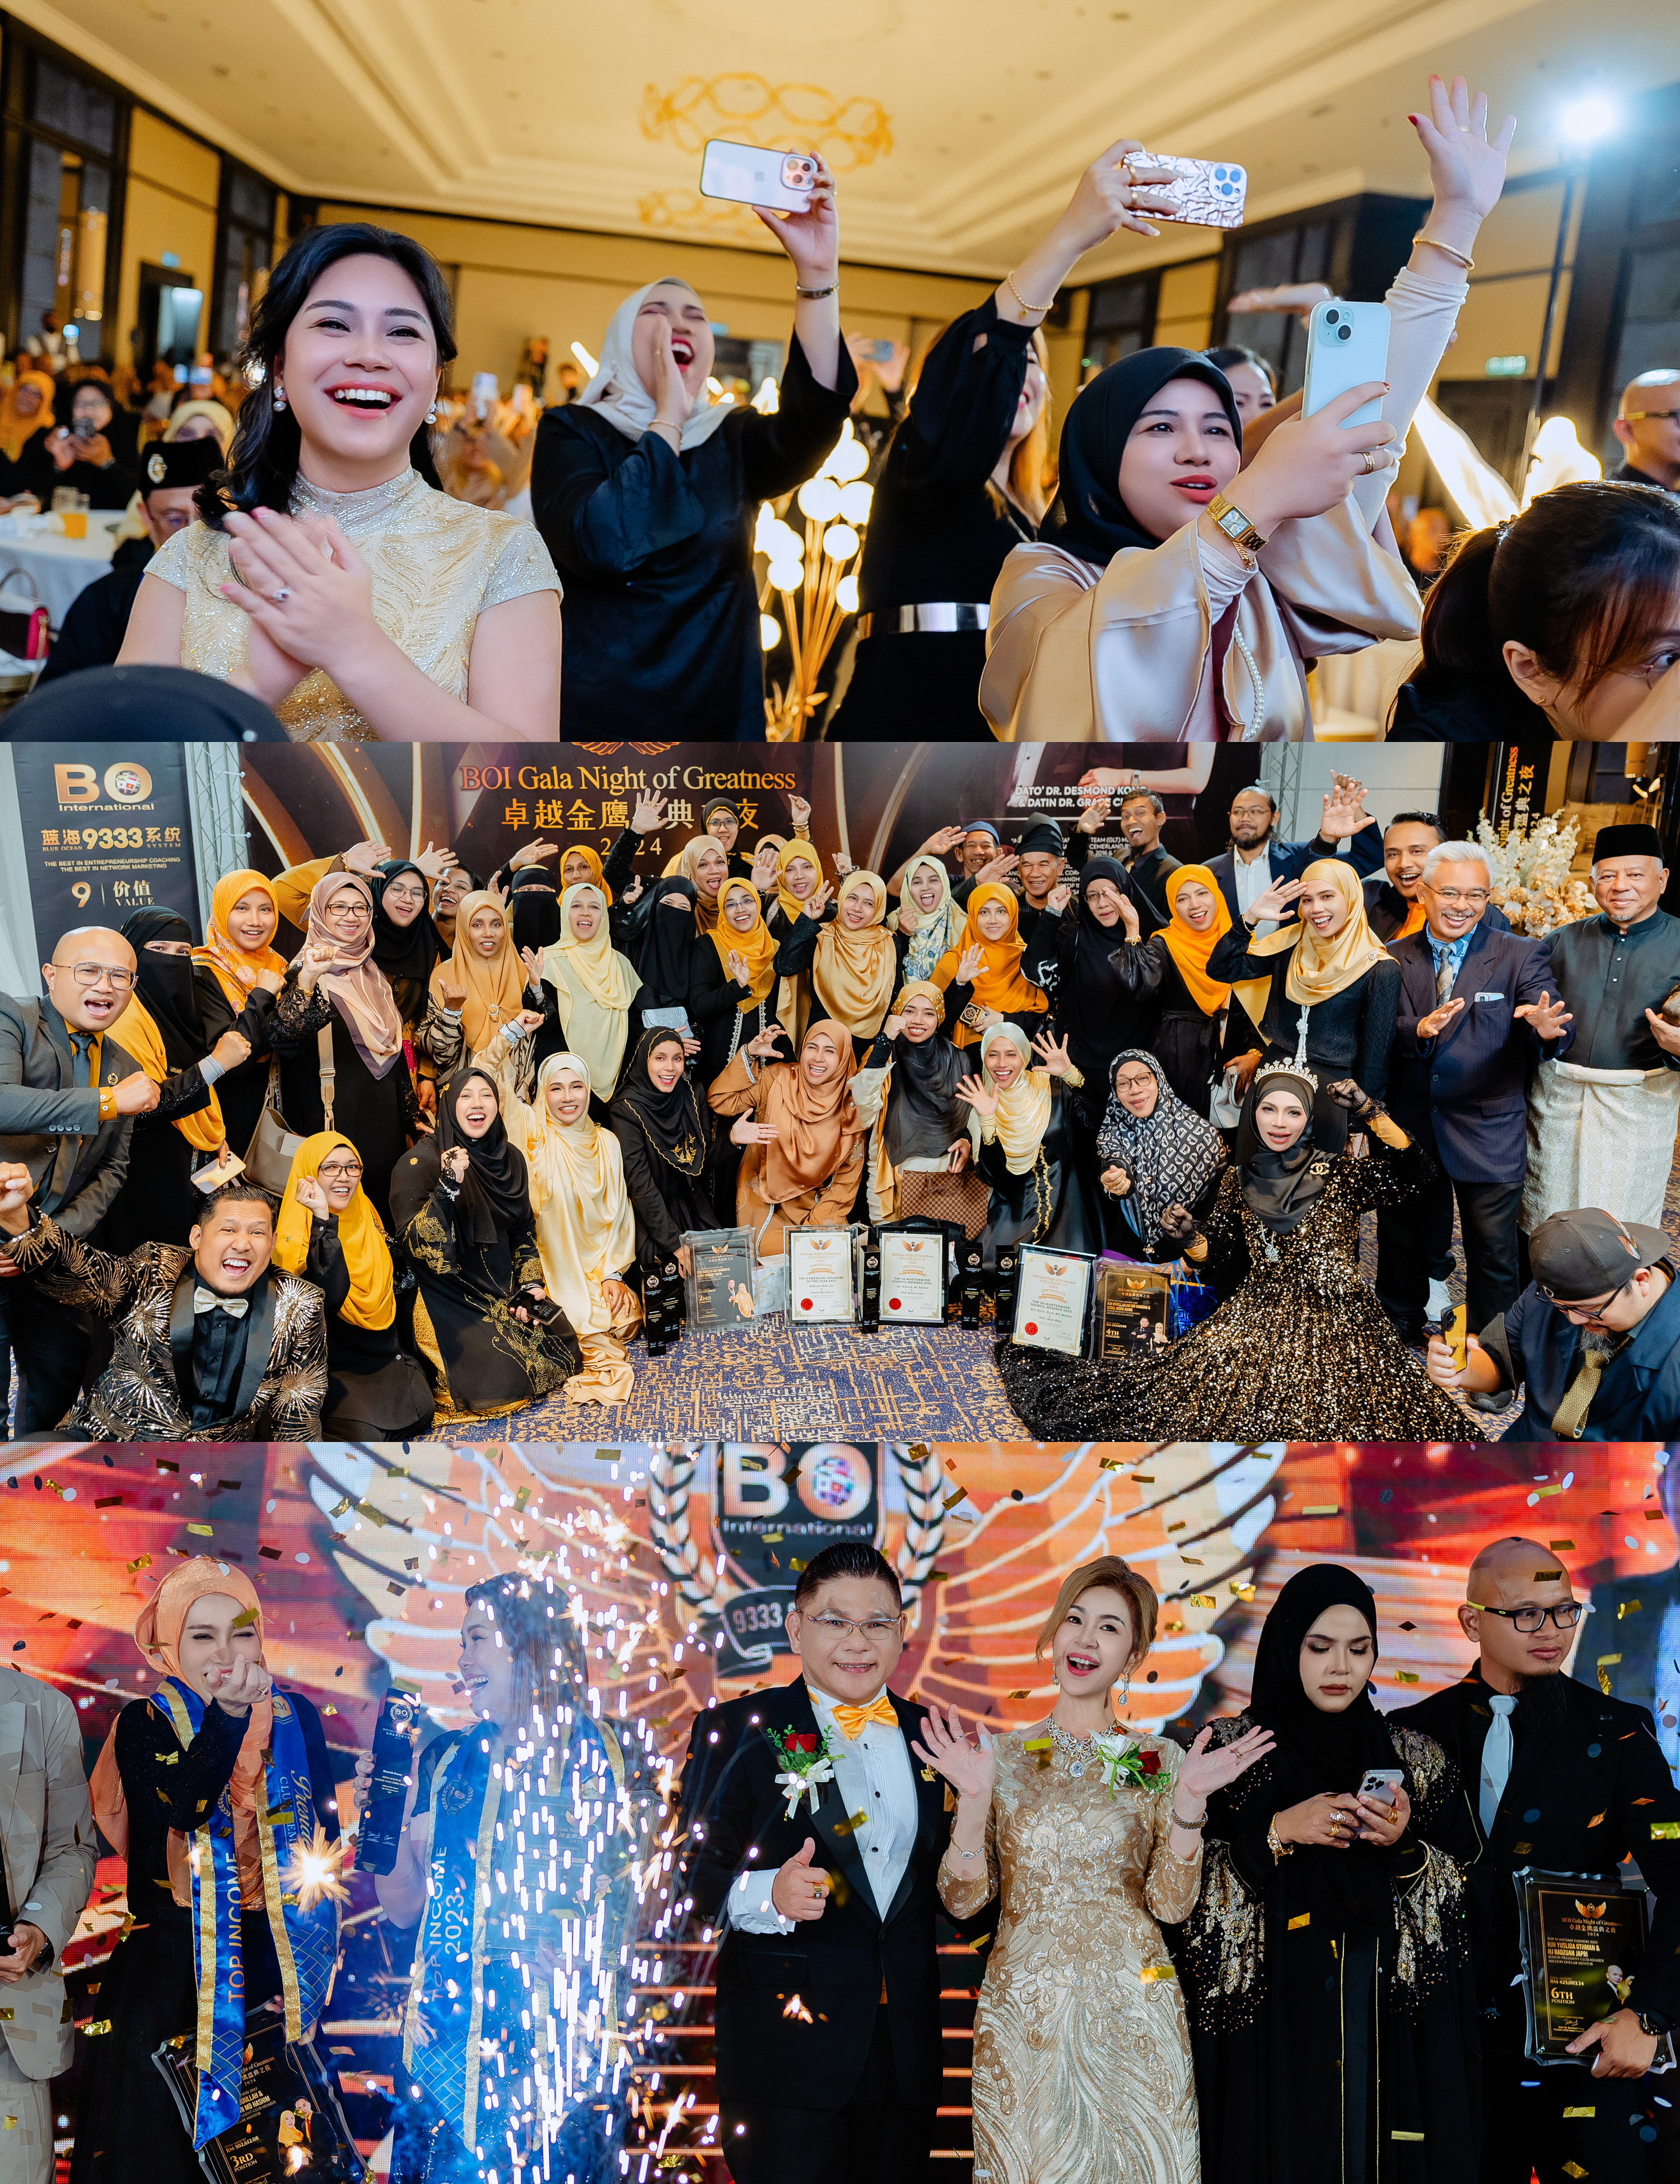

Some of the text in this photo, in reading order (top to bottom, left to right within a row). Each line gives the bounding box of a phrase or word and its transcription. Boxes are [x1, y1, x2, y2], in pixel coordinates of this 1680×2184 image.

[54, 762, 152, 804] BO
[460, 764, 796, 796] BOI Gala Night of Greatness
[1500, 746, 1518, 818] of Greatness
[1046, 786, 1061, 796] DR.
[1064, 786, 1115, 796] DESMOND
[59, 803, 155, 811] International
[1018, 798, 1025, 807] &
[1028, 798, 1057, 807] DATIN
[1058, 798, 1075, 807] DR.
[501, 799, 759, 831] 卓越金鹰典夜
[600, 837, 662, 856] 224
[71, 881, 91, 908] 9
[113, 880, 151, 898] 价值
[115, 897, 155, 907] VALUE
[723, 1442, 873, 1520] BO
[722, 1520, 874, 1537] International
[732, 1602, 783, 1633] 9333
[226, 1852, 245, 2004] TOP INCOME
[429, 1846, 447, 2003] TOP INCOME
[445, 1894, 465, 1955] 2023
[1551, 1987, 1573, 1999] 6TH
[254, 2056, 275, 2068] Greatness
[252, 2095, 270, 2107] HASHIM
[262, 2100, 276, 2109] MEMBER
[247, 2111, 261, 2121] MENTOR
[235, 2135, 259, 2149] 502,612.08
[230, 2153, 253, 2168] 3RD
[234, 2159, 258, 2172] POSITION
